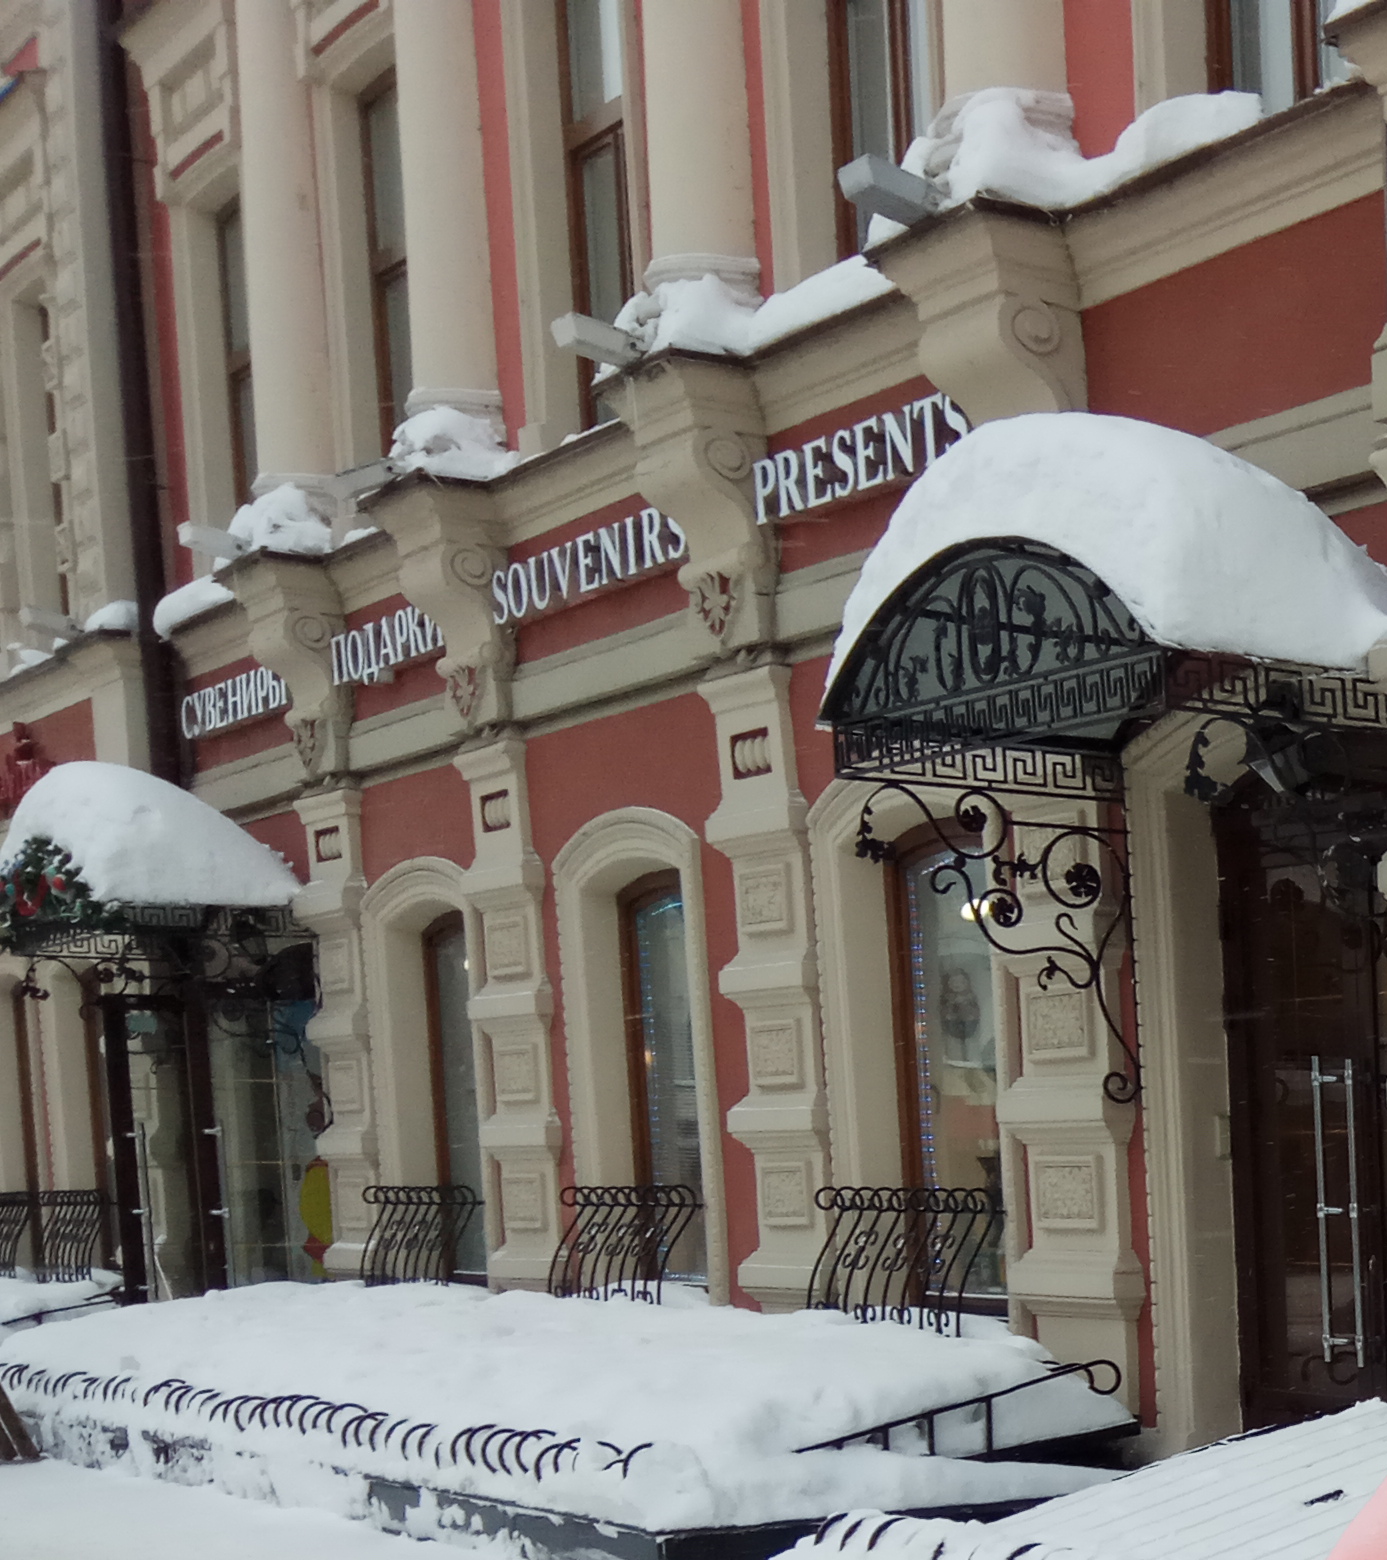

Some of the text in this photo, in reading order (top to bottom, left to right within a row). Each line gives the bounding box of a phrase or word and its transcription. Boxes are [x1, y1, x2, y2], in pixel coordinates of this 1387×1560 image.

[753, 392, 973, 526] PRESENTS
[491, 507, 686, 625] SOUVENIRS
[330, 606, 445, 686] ПОДАРКИ
[180, 666, 288, 740] СУВЕНИРЫ
